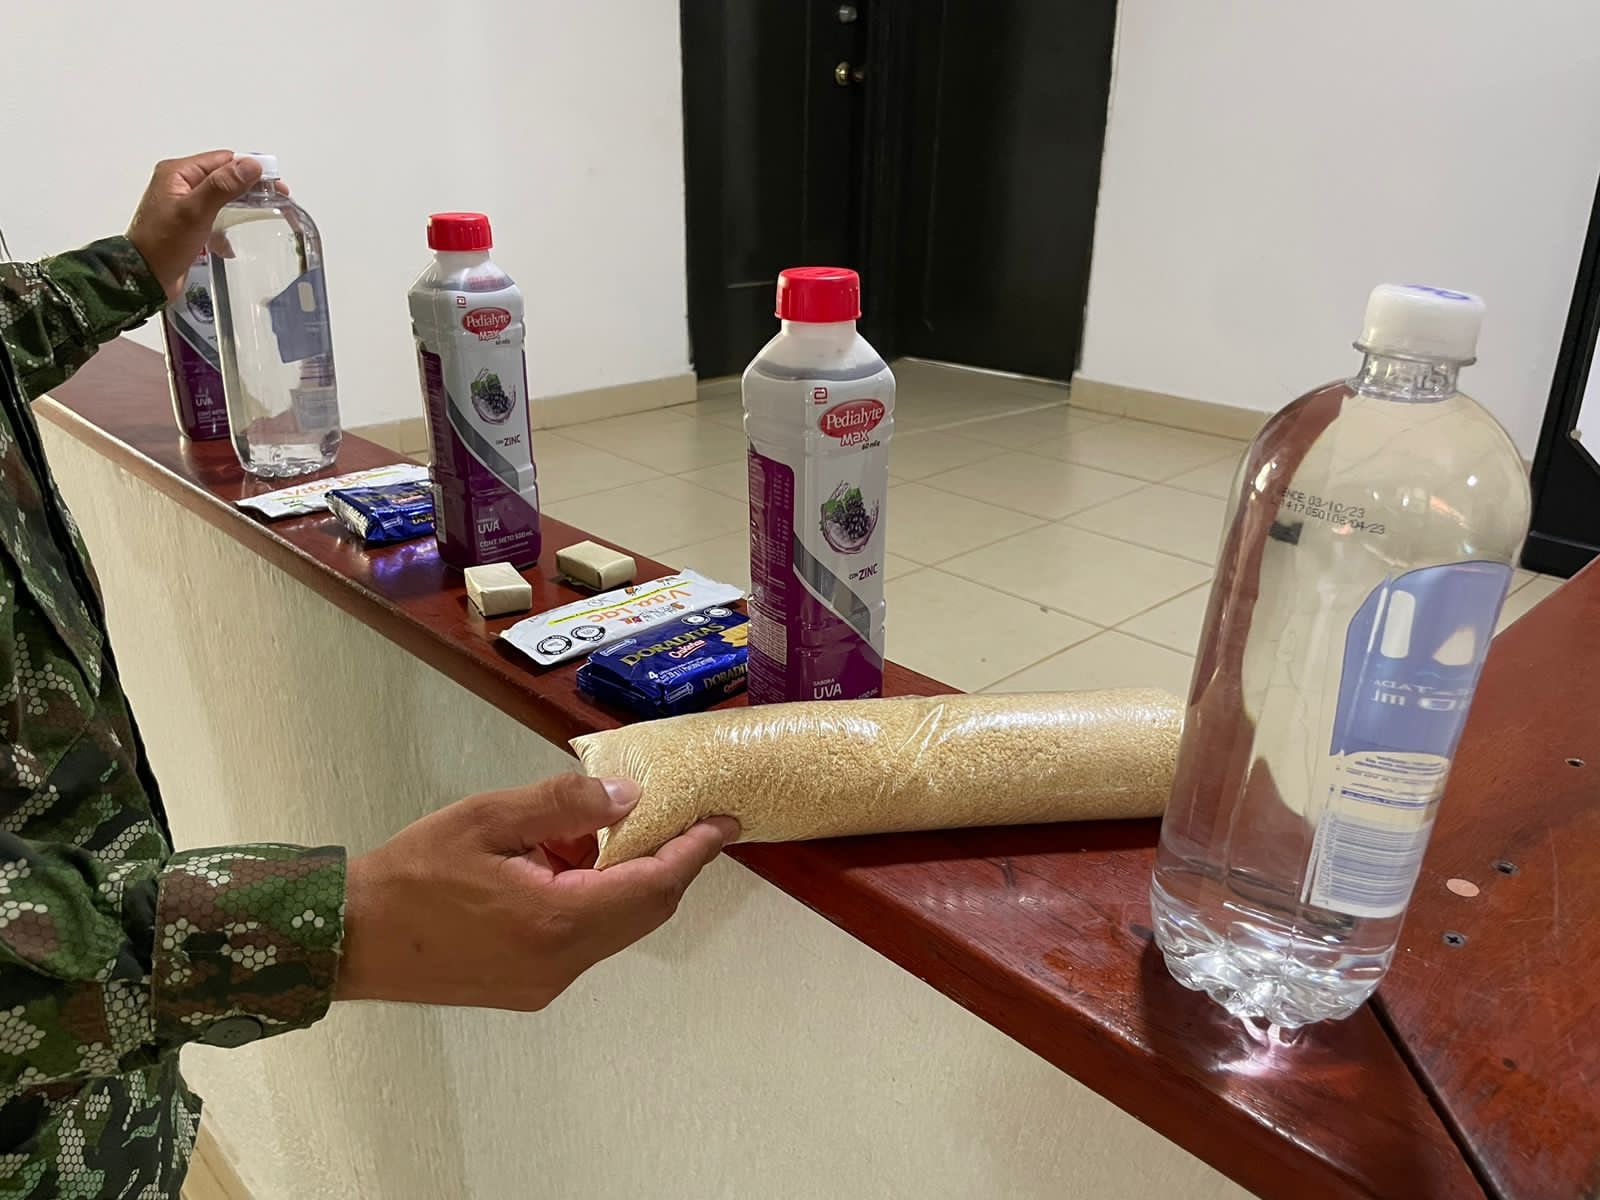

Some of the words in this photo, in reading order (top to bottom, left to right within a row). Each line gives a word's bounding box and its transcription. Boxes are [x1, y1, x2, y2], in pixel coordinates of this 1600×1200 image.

[466, 313, 510, 328] Pedialyte
[826, 405, 883, 431] Pedialyte
[840, 429, 870, 447] Max
[1308, 494, 1365, 519] 03/10/23
[477, 520, 501, 534] UVA
[859, 562, 879, 580] ZINC
[638, 589, 693, 607] Vita
[586, 607, 633, 623] Lac
[620, 623, 726, 667] DORADITAS
[647, 671, 659, 680] 4
[813, 683, 843, 700] UVA
